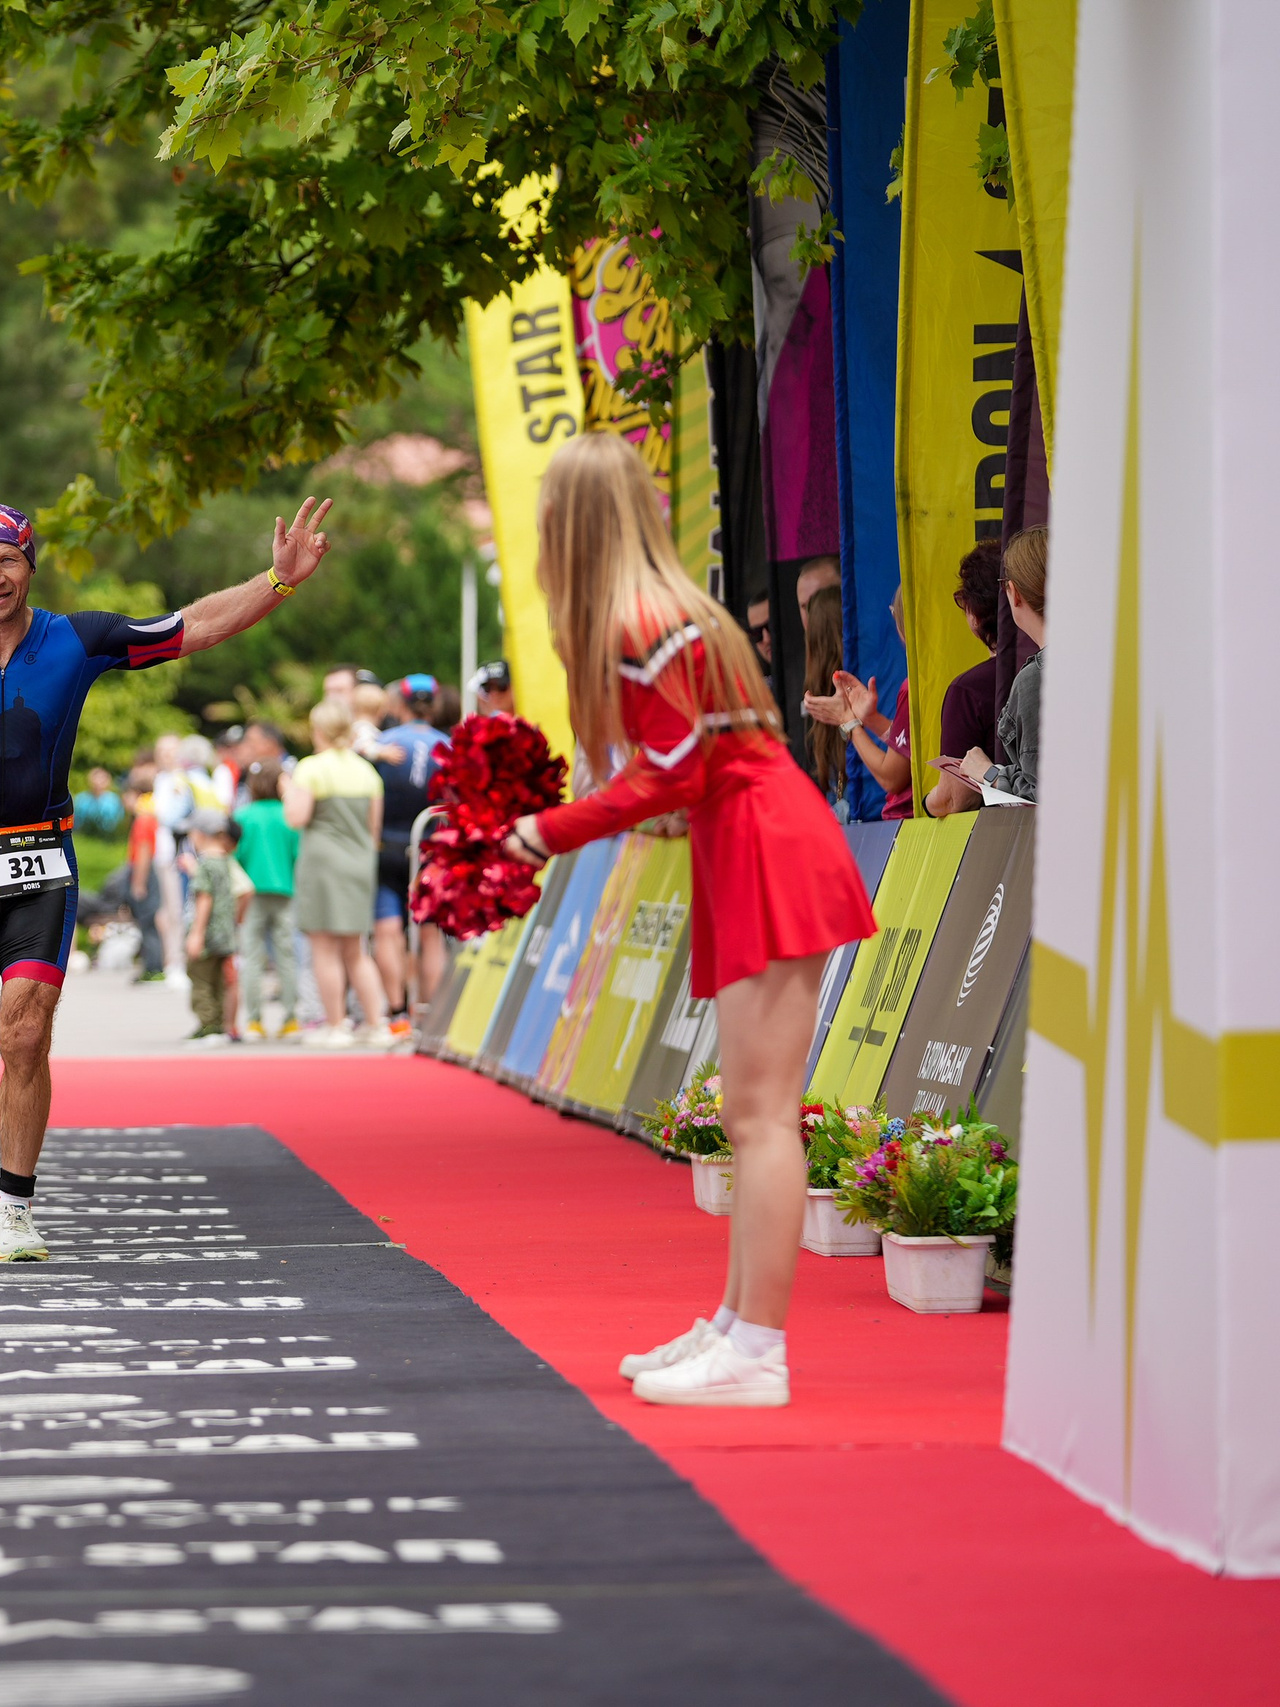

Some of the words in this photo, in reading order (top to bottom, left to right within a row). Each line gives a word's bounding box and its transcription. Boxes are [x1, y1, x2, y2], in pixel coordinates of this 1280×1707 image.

[510, 303, 578, 445] STAR
[8, 855, 46, 879] 321
[22, 882, 41, 891] BORIS
[38, 1296, 305, 1308] STAR
[54, 1356, 358, 1373] STAR
[69, 1431, 419, 1453] STAR
[85, 1538, 503, 1566] STAR
[97, 1602, 562, 1634] STAR
